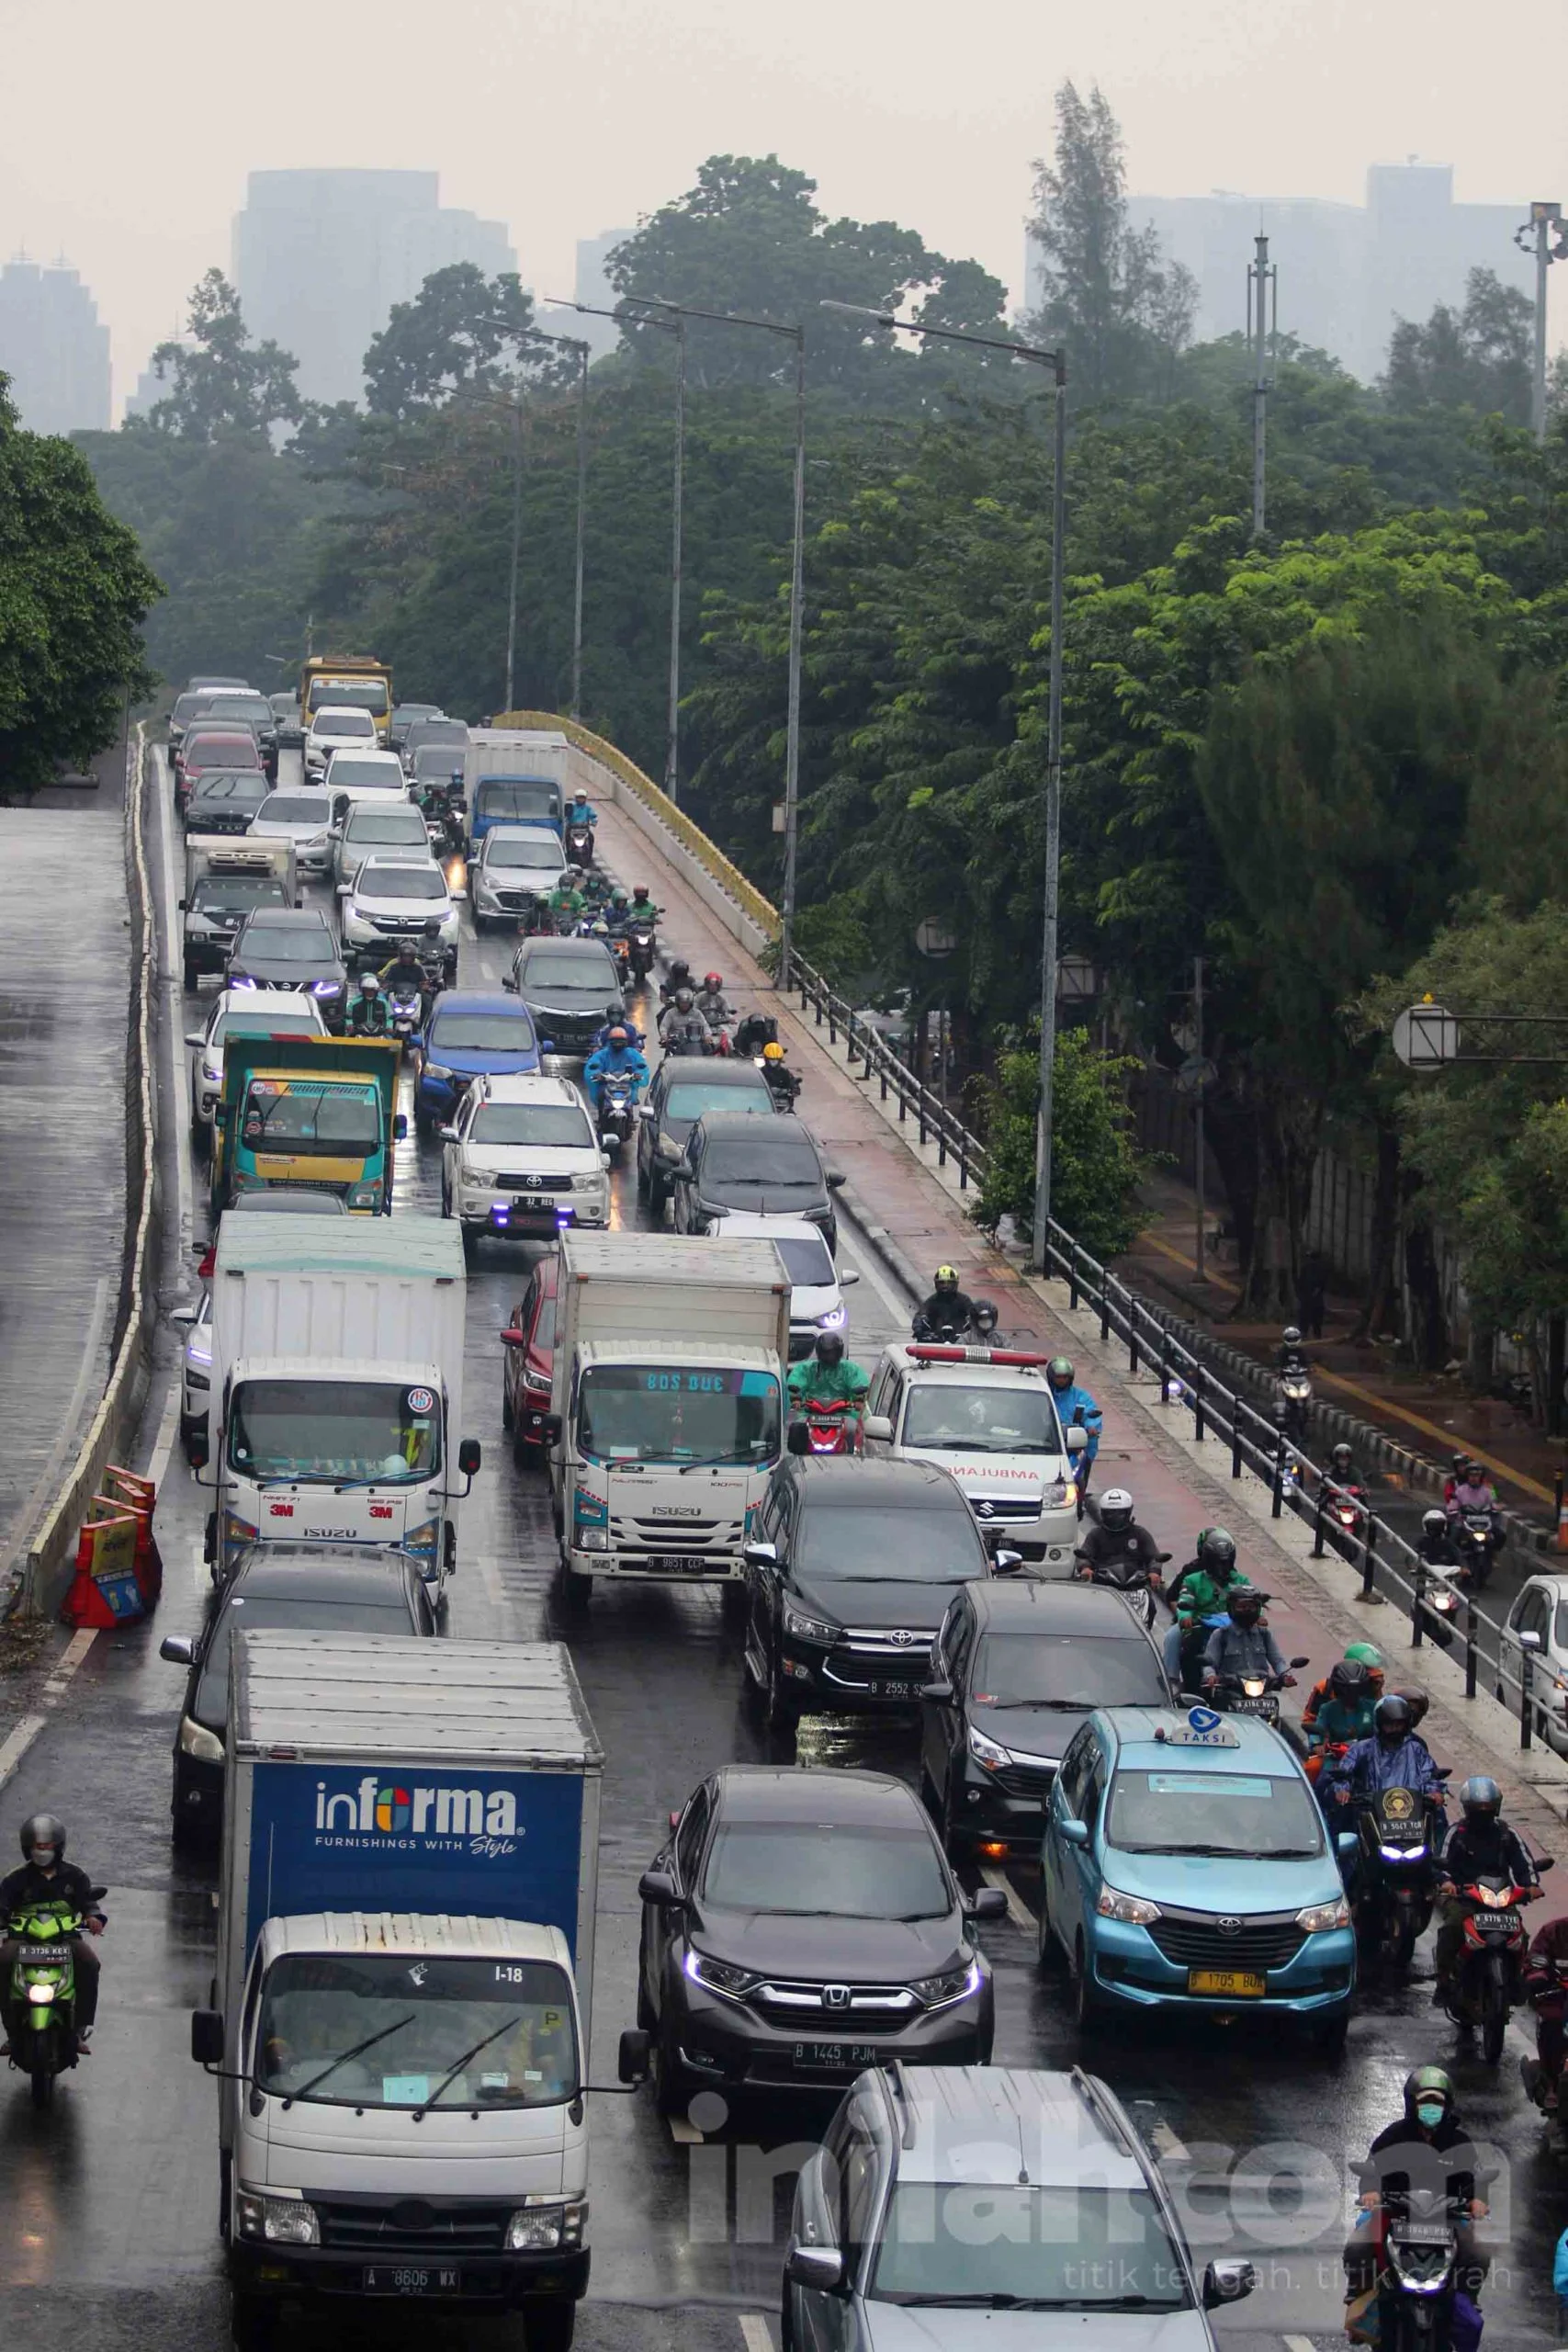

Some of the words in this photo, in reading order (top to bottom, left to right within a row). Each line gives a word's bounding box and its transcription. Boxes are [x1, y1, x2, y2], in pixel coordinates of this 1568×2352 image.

[270, 1504, 294, 1517] 3M
[369, 1506, 393, 1519] 3M
[652, 1506, 702, 1517] ISUZU
[303, 1528, 357, 1538] ISUZU
[871, 1681, 877, 1693] B
[886, 1682, 908, 1694] 2552
[1182, 1732, 1225, 1743] TAKSI
[316, 1776, 516, 1836] informa
[315, 1837, 416, 1849] FURNISHINGS
[425, 1840, 462, 1850] WITH
[468, 1836, 517, 1858] Style
[1208, 1973, 1235, 1987] 1705
[795, 2043, 804, 2058] B
[813, 2044, 841, 2060] 1445
[852, 2045, 876, 2062] PJM
[367, 2268, 376, 2285] A
[394, 2269, 429, 2287] 8606
[439, 2270, 457, 2287] WX
